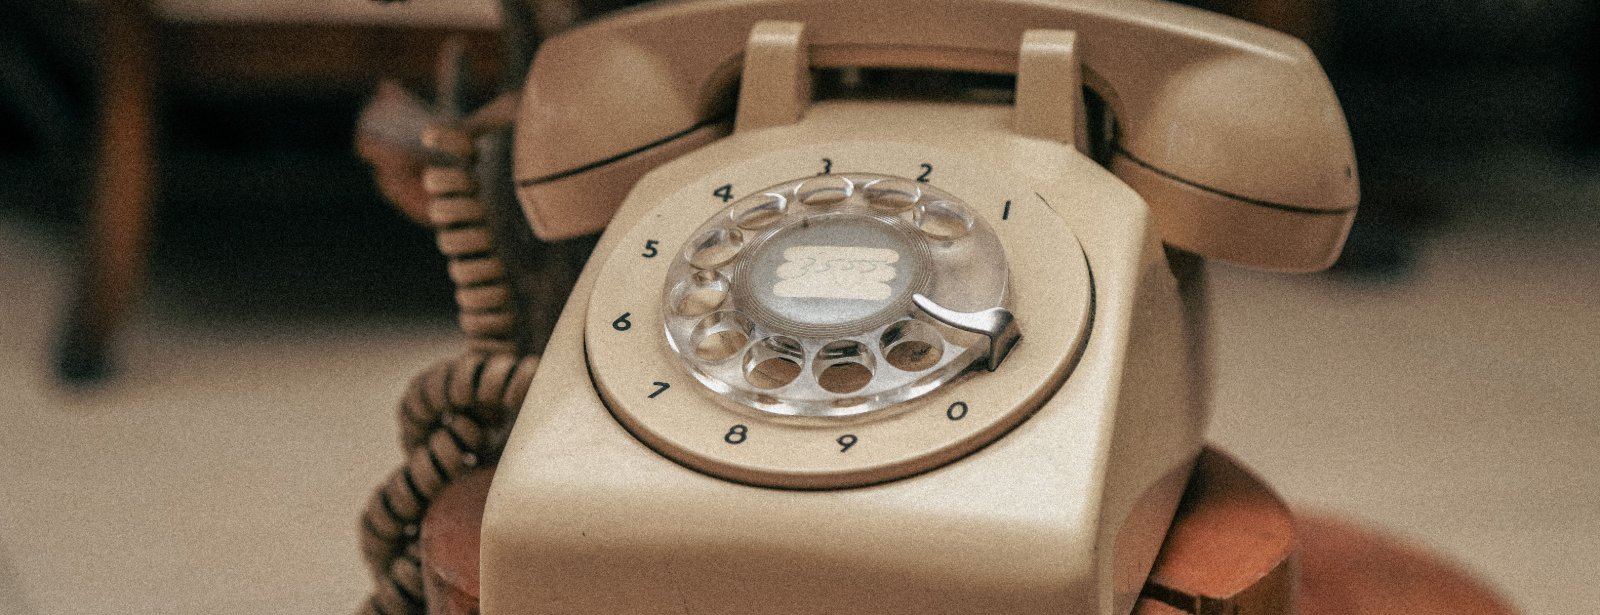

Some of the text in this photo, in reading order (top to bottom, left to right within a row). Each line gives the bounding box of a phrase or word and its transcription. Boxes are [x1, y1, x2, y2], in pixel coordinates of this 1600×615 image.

[816, 158, 833, 177] 3
[916, 163, 933, 184] 2
[713, 184, 734, 203] 4
[1002, 200, 1011, 221] 1
[642, 239, 662, 259] 5
[612, 312, 632, 332] 6
[648, 381, 671, 399] 7
[946, 401, 969, 421] 0
[724, 424, 748, 445] 8
[836, 434, 858, 453] 9
